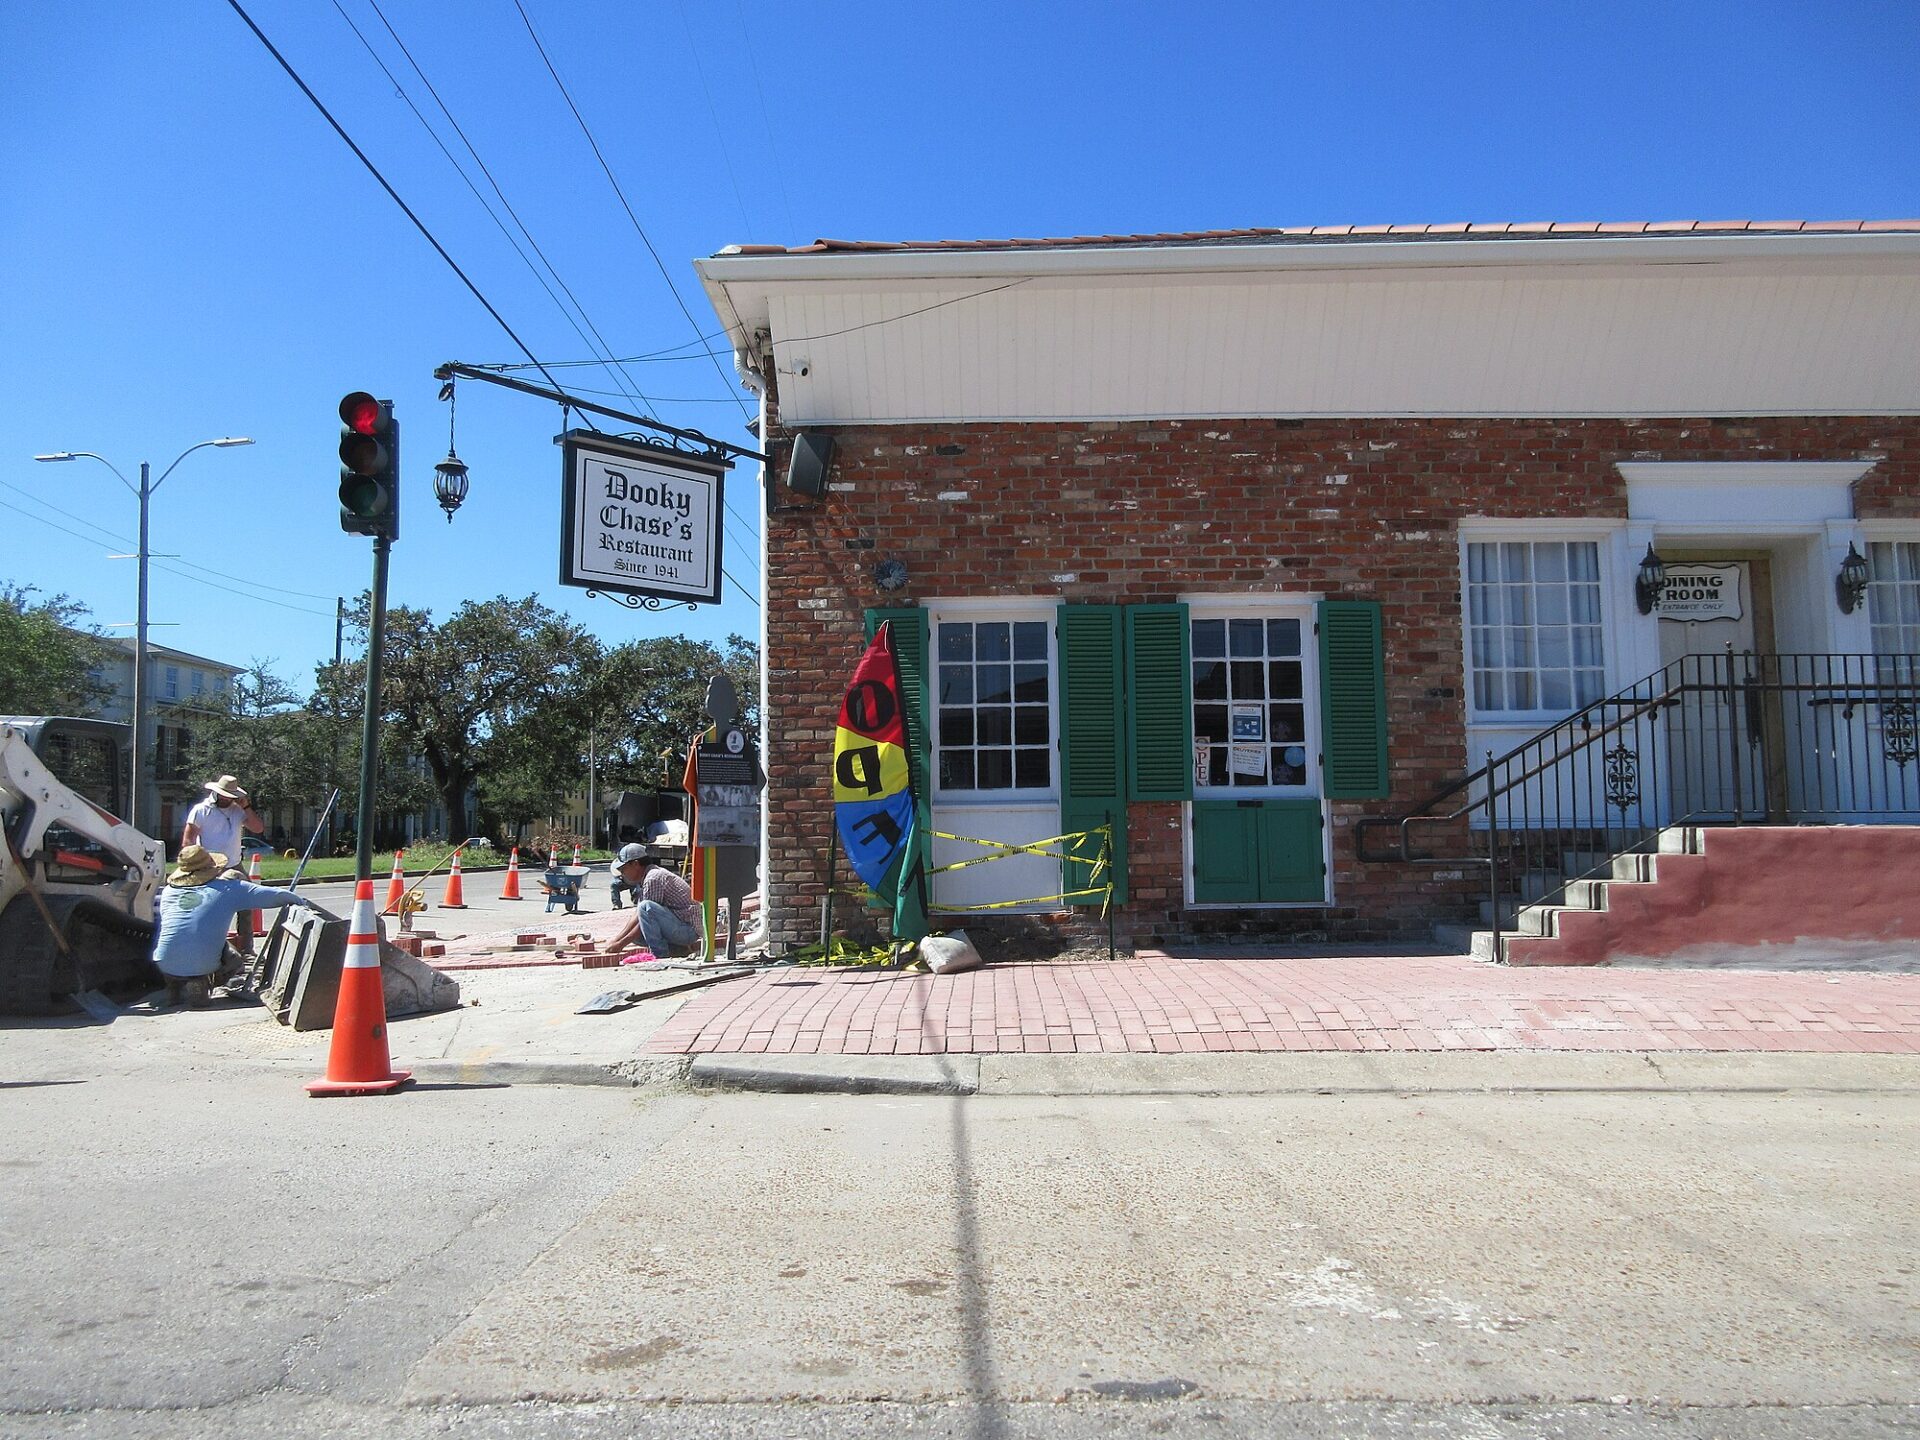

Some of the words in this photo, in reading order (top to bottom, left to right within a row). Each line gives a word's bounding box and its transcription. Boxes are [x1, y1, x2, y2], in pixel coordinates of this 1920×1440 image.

[604, 468, 691, 518] Dooky
[600, 505, 693, 541] Chase's
[599, 532, 693, 563] Restaurant
[614, 558, 648, 574] Since
[654, 564, 679, 578] 1941
[1662, 576, 1722, 587] DINING
[1666, 589, 1718, 600] ROOM
[1662, 603, 1701, 611] ENTRANCE
